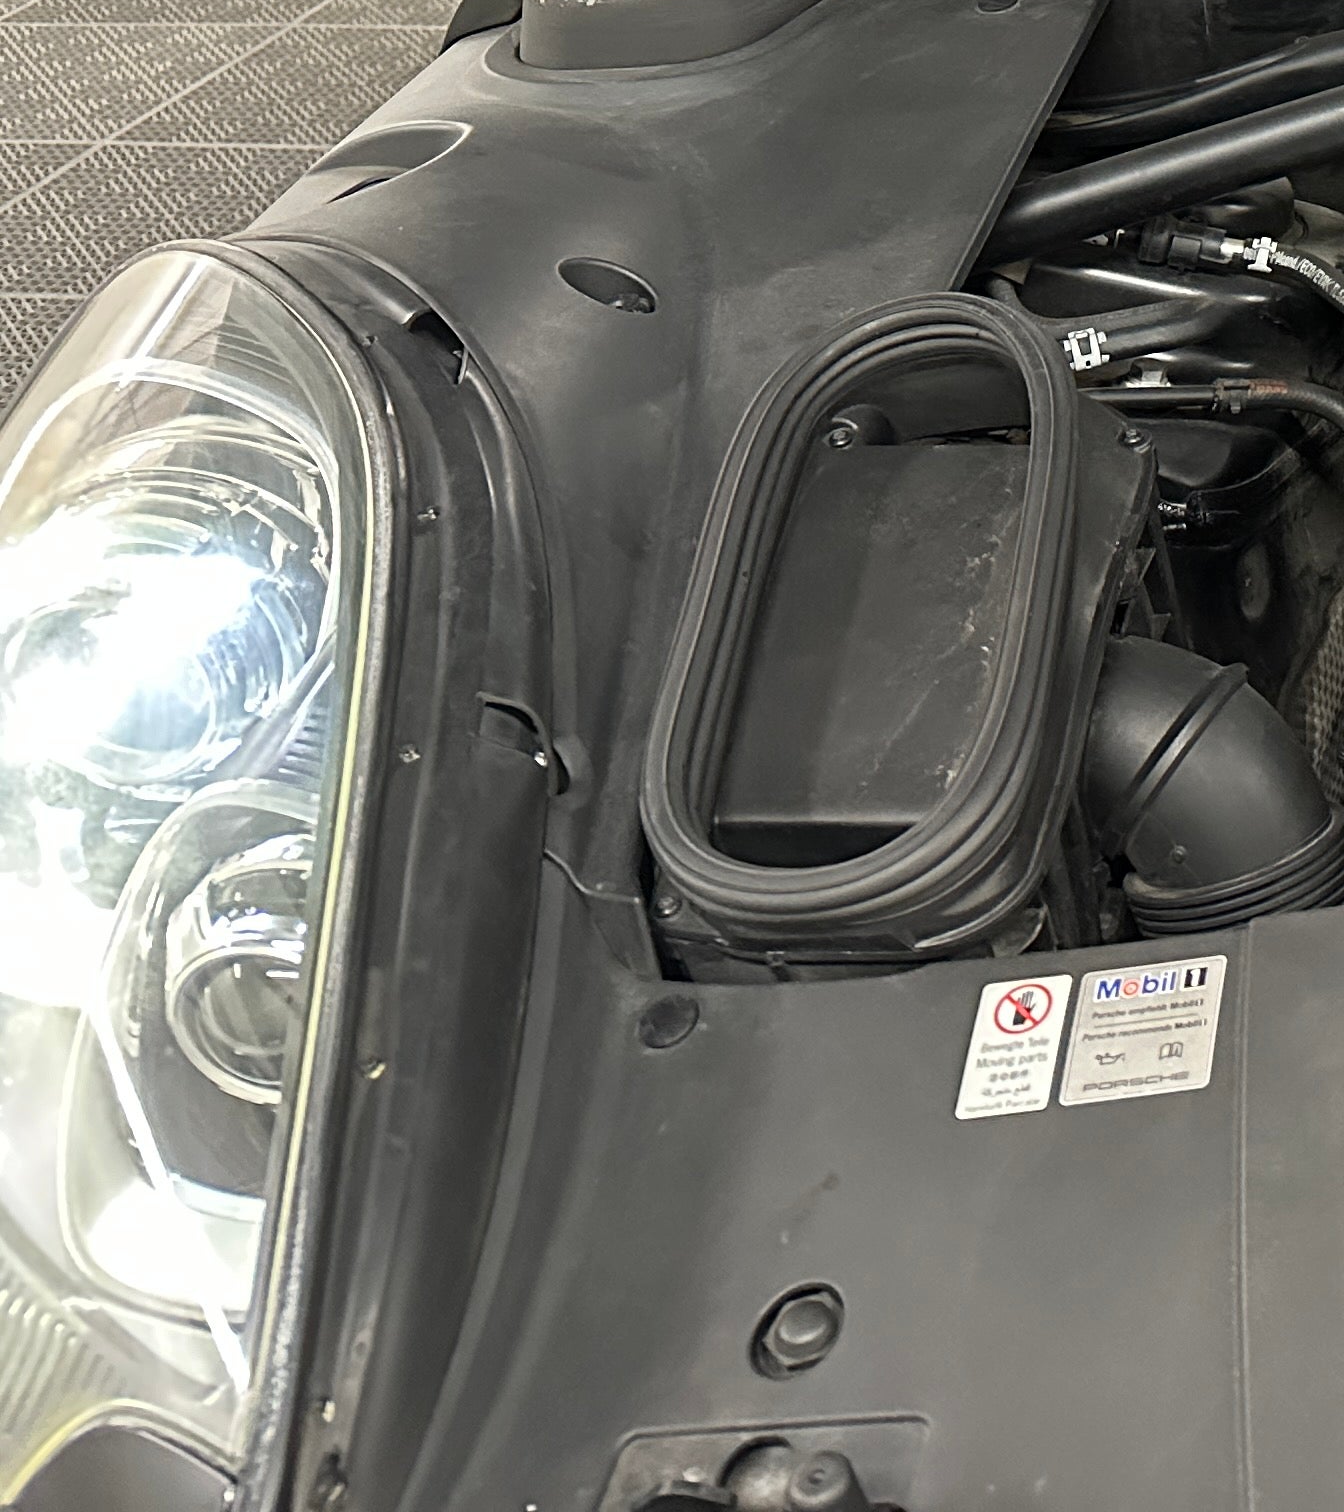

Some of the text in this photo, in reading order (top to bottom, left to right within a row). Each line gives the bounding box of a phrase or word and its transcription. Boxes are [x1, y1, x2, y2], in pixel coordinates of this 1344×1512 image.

[1096, 967, 1208, 1000] Mobil 1
[976, 1056, 1015, 1068] Moving
[1083, 1071, 1190, 1092] PORSCHE
